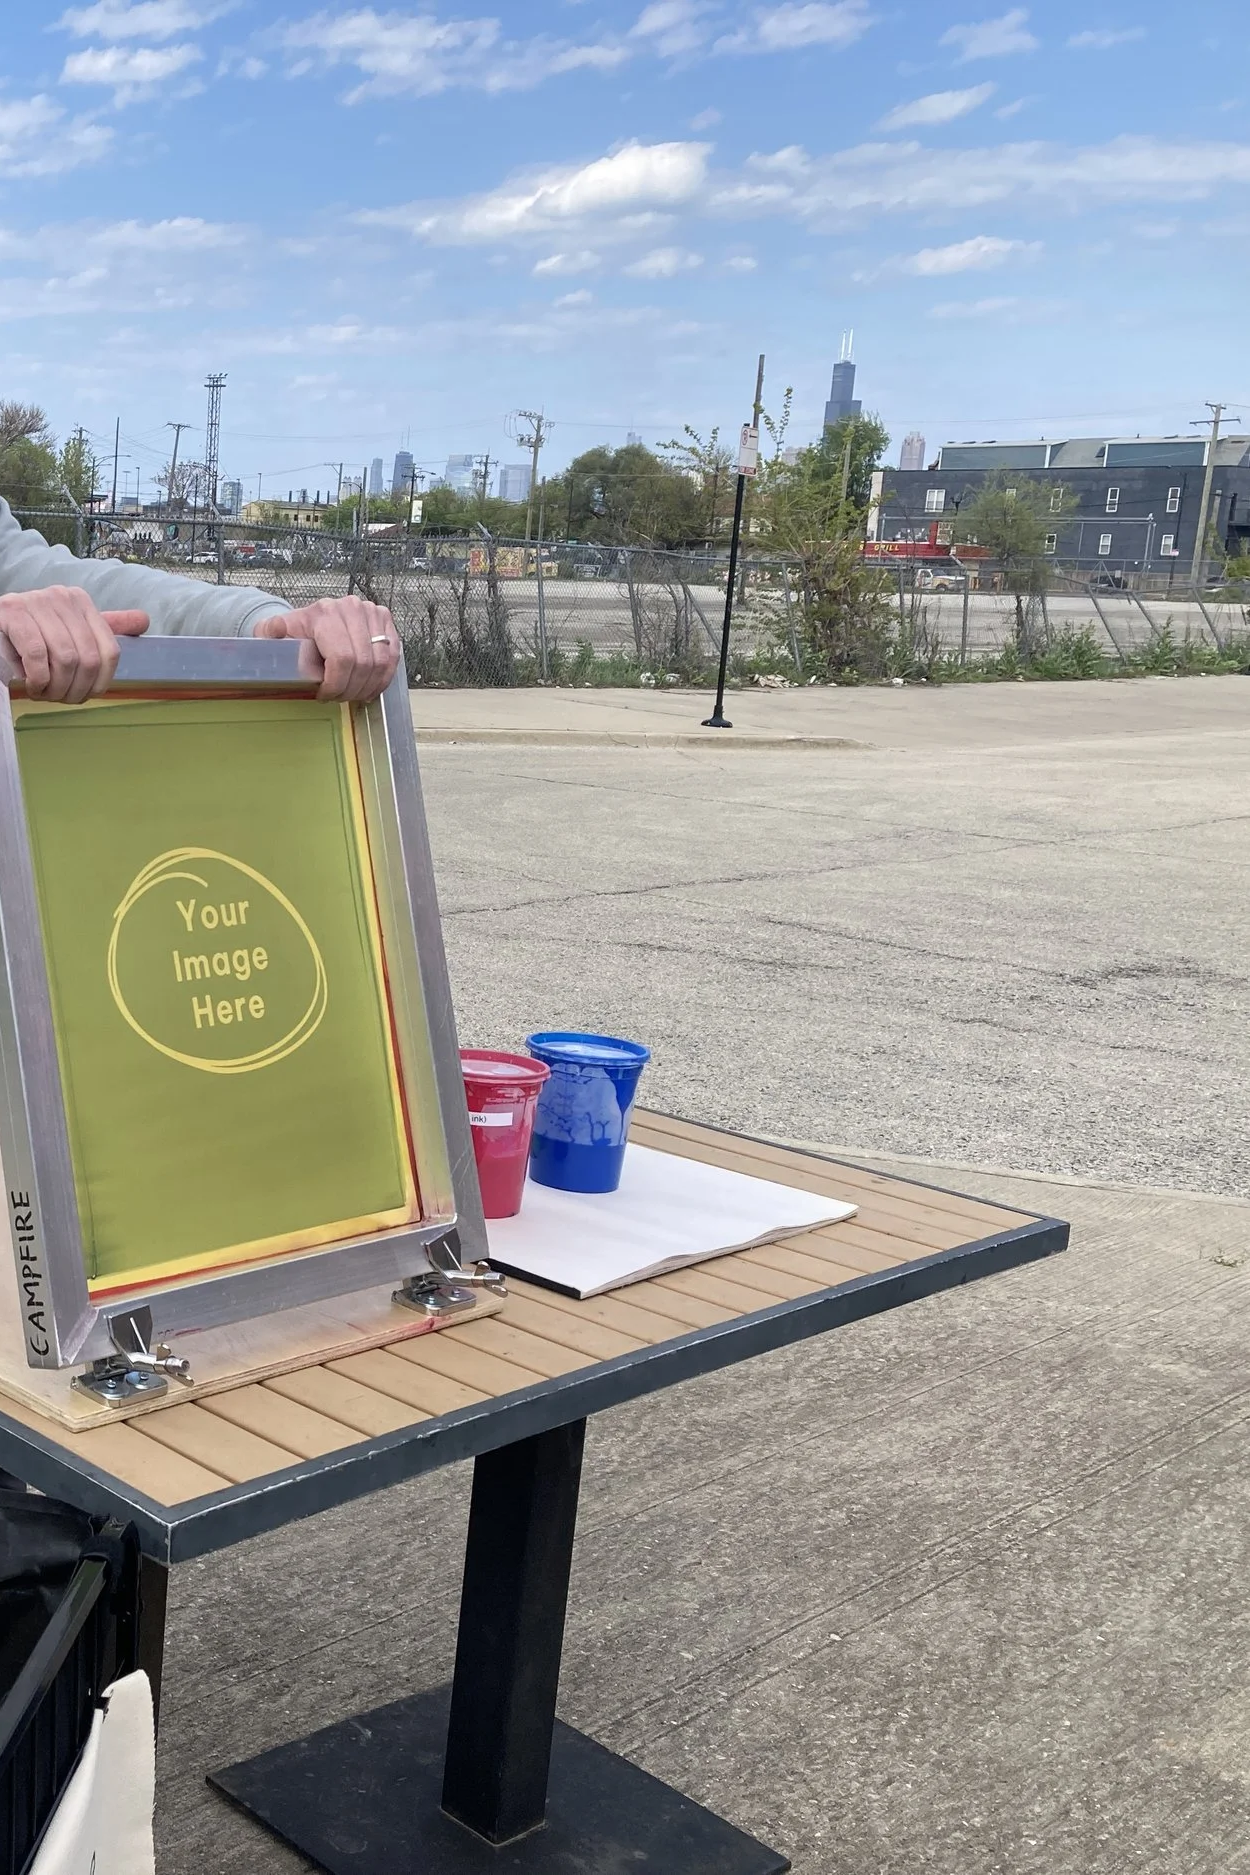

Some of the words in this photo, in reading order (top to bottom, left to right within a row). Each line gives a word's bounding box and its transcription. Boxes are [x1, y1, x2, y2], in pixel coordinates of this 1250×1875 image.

[175, 897, 250, 932] Your
[172, 945, 270, 982] Image
[191, 993, 266, 1029] Here
[471, 1115, 487, 1124] ink)
[10, 1190, 50, 1357] CAMPFIRE
